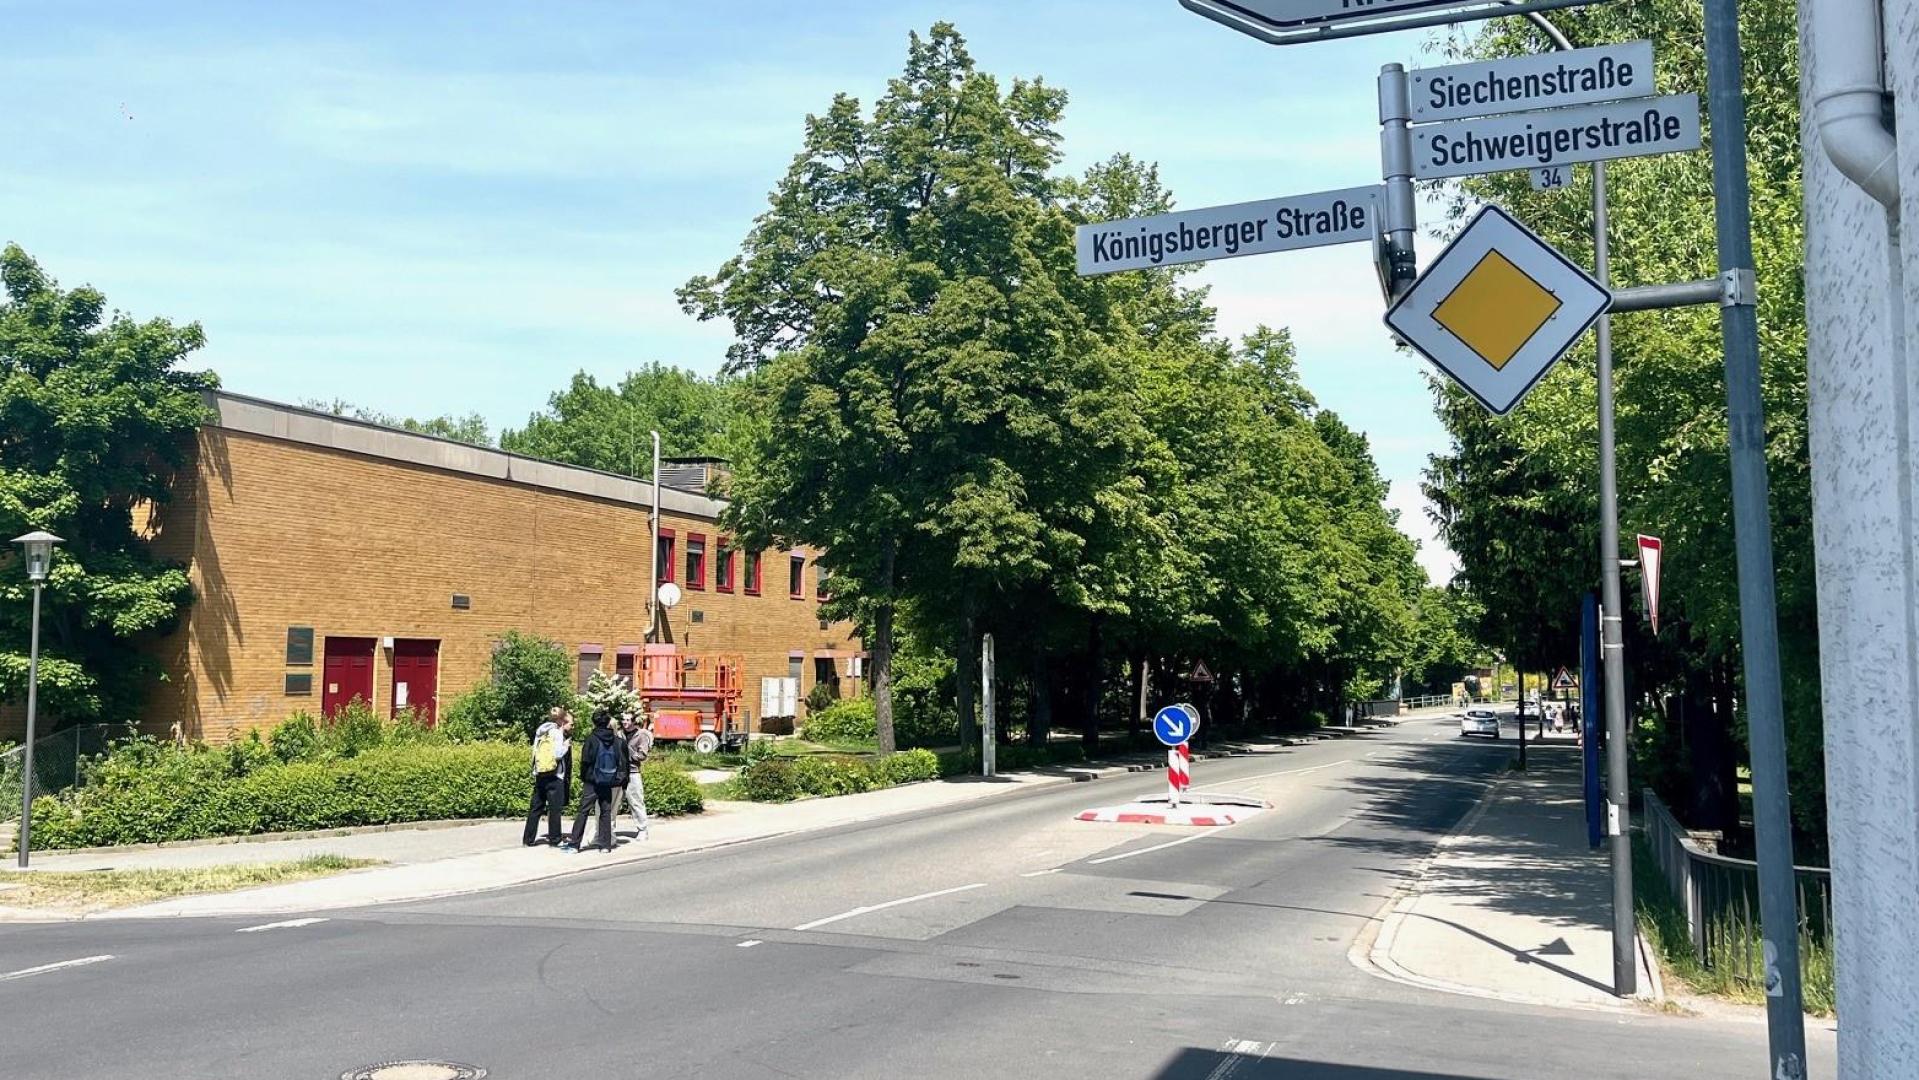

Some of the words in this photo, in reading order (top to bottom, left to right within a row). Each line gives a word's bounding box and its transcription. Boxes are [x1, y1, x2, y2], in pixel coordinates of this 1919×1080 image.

[1429, 56, 1634, 109] Siechenstraße
[1431, 109, 1681, 166] Schweigerstraße
[1541, 167, 1562, 188] 34
[1092, 218, 1268, 264] Königsberger
[1276, 200, 1365, 238] Straße
